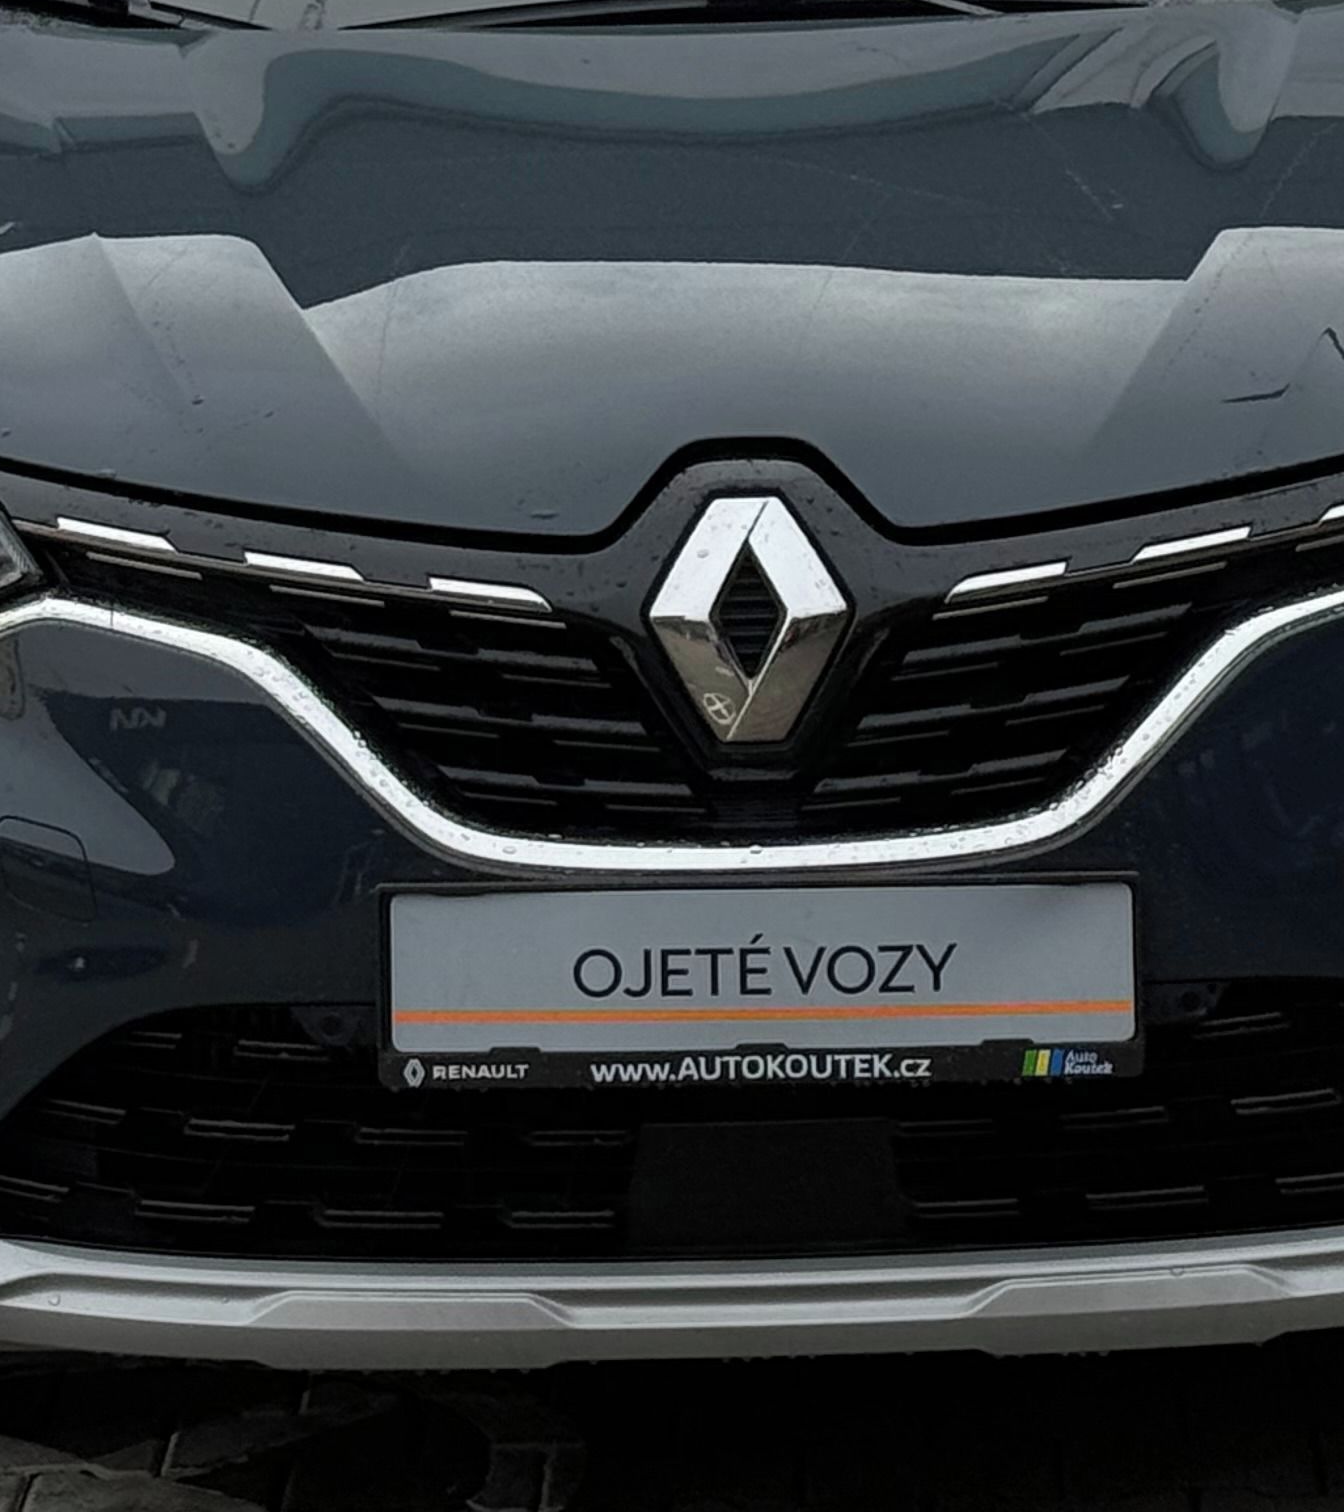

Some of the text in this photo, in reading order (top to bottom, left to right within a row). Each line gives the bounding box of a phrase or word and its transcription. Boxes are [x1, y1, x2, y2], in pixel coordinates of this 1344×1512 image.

[571, 933, 958, 999] OJETÉ VOZY
[1064, 1048, 1098, 1064] Auto
[432, 1063, 530, 1080] RENAULT
[589, 1053, 933, 1083] www.AUTOKOUTEK.cz
[1064, 1061, 1114, 1075] Koutek
